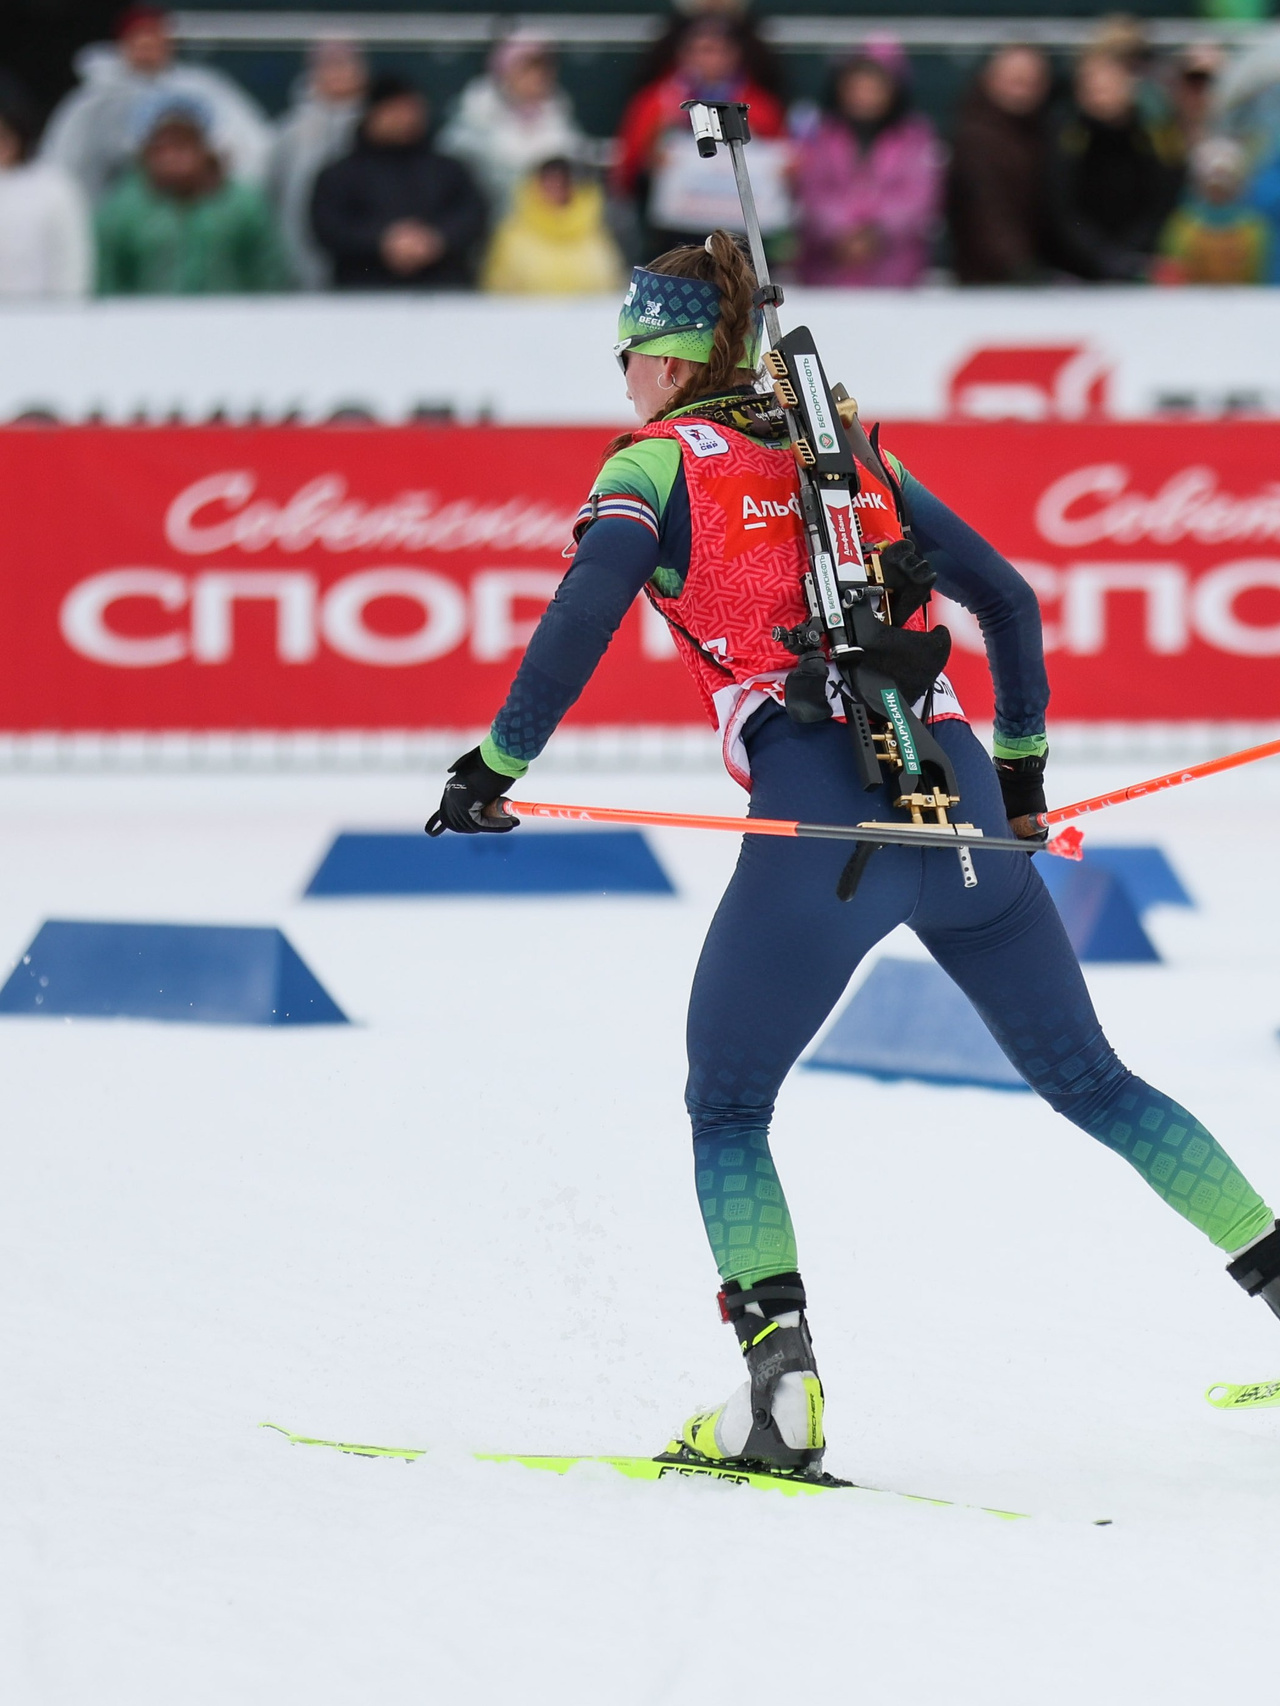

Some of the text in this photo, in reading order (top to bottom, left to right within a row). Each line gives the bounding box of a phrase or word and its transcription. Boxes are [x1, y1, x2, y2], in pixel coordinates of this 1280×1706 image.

[803, 357, 826, 428] БЕЛОРУСНЕФТЬ
[165, 470, 573, 556] Советски
[742, 492, 888, 521] Альф анк
[838, 514, 850, 557] Альфа Банк
[820, 555, 836, 610] БЕЛОРУСНЕФТЬ
[885, 692, 915, 760] БЕЛАРУСБАНК
